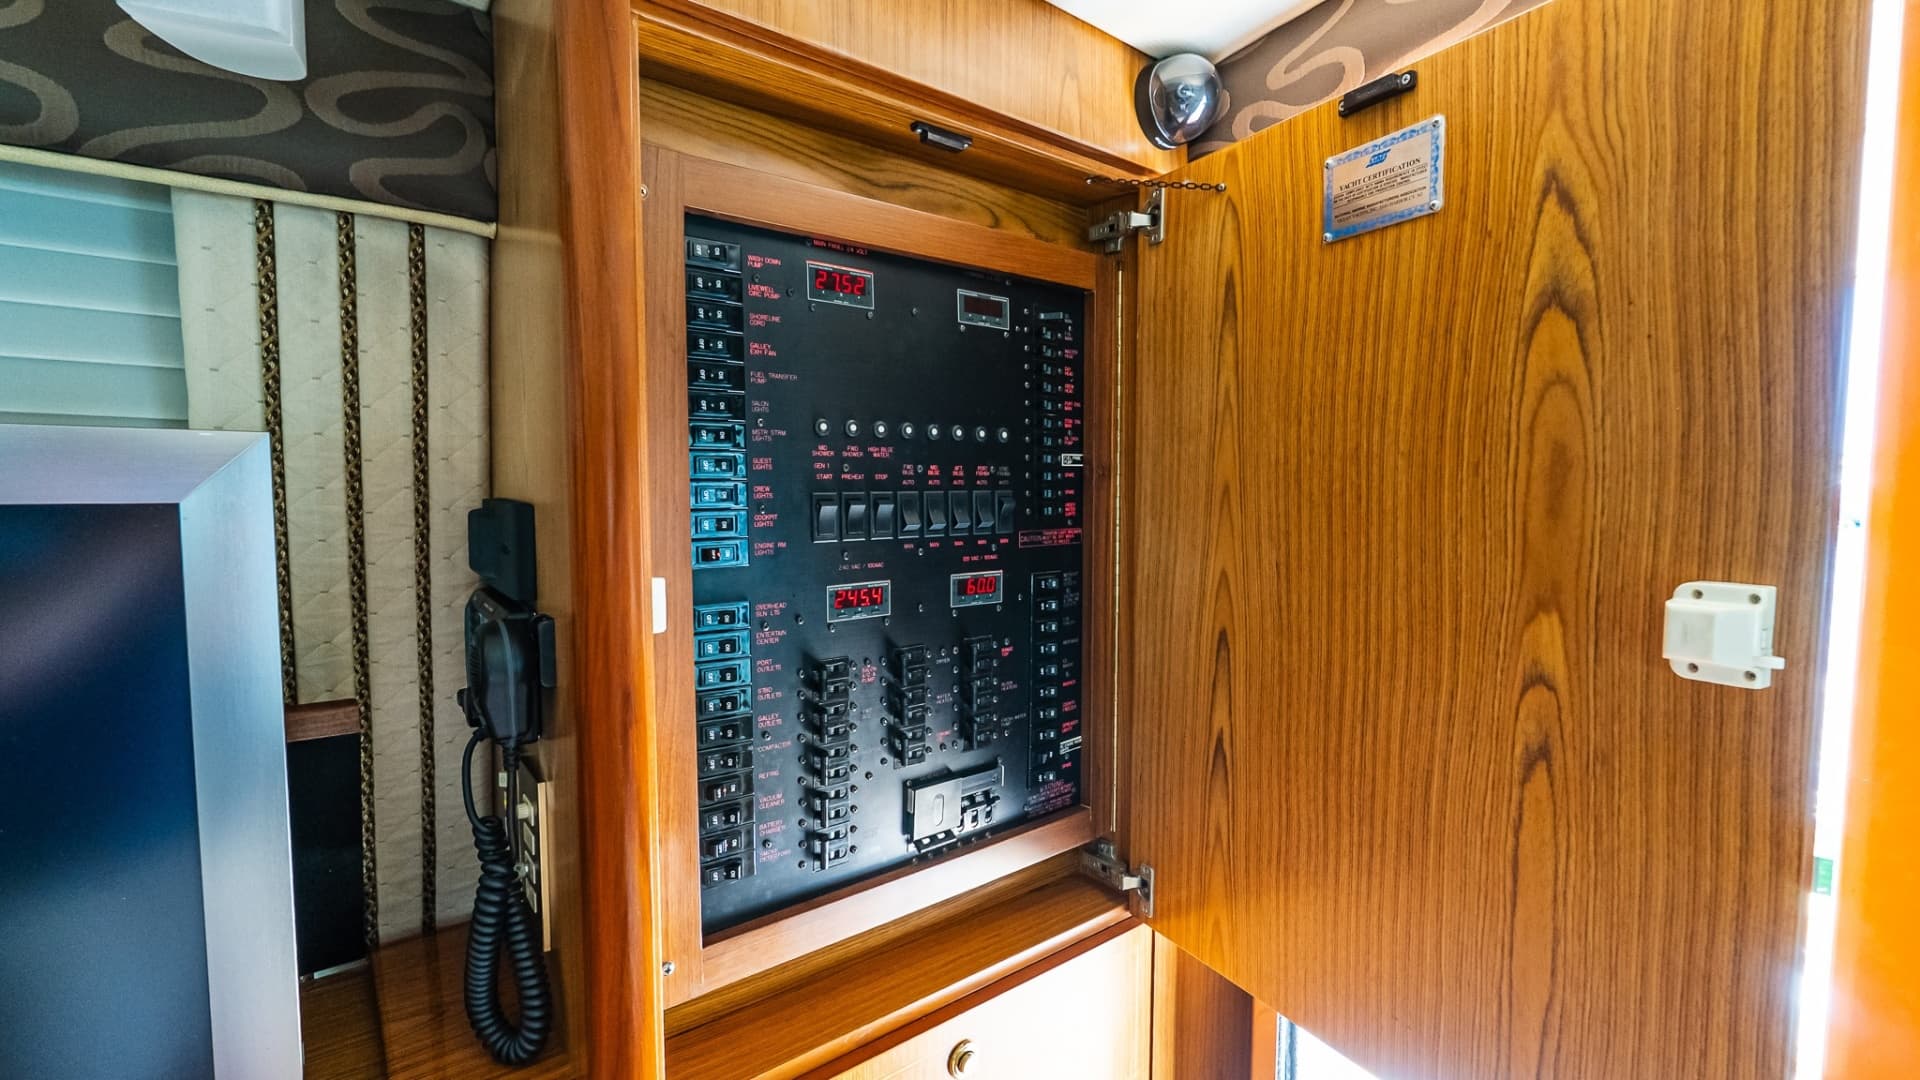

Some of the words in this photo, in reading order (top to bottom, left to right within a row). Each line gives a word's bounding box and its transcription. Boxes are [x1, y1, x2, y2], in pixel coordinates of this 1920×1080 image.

[1340, 179, 1362, 191] YACHT
[1363, 158, 1421, 183] CERTIFICATION
[765, 257, 781, 265] DOWN
[748, 283, 774, 293] LIVEWELL
[750, 313, 780, 323] SHORELINE
[750, 342, 771, 350] GALLEY
[768, 373, 798, 381] TRANSFER
[756, 603, 787, 611] OVERHEAD
[759, 799, 784, 809] CLEANER
